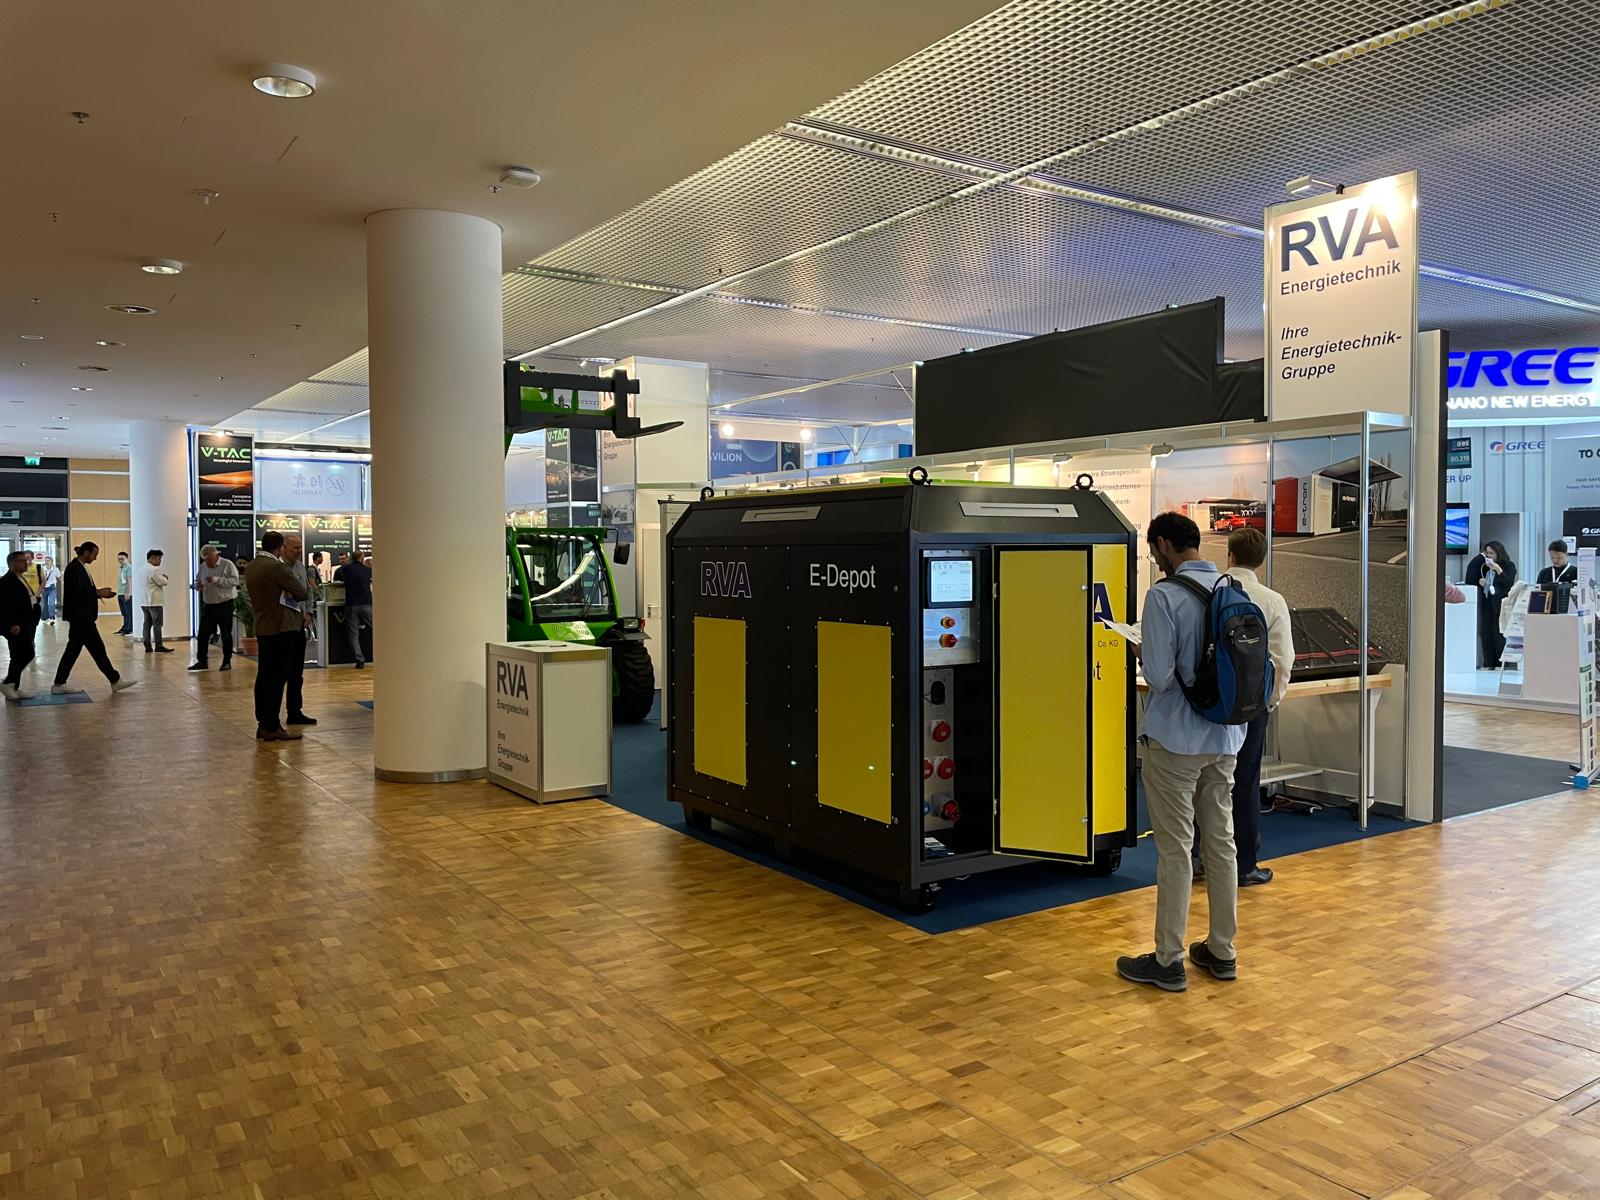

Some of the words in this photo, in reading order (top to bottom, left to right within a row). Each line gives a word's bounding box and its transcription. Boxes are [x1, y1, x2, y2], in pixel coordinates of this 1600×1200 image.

[1281, 206, 1399, 272] RVA
[1281, 260, 1401, 295] Energietechnik
[1281, 326, 1309, 340] Ihre
[1281, 330, 1402, 360] Energietechnik-
[1281, 363, 1336, 380] Gruppe
[1491, 395, 1528, 408] NEW
[547, 429, 568, 442] V-TAC
[200, 446, 251, 458] V-TAC
[1506, 440, 1546, 451] GREE
[1578, 449, 1593, 459] TO
[1459, 475, 1472, 483] UP
[203, 518, 250, 528] V-TAC
[256, 519, 300, 529] V-TAC
[308, 519, 350, 529] V-TAC
[701, 562, 752, 598] RVA
[809, 563, 876, 594] E-Depot
[1109, 639, 1119, 647] KG
[497, 660, 529, 700] RVA
[497, 699, 529, 716] Energietechnik
[497, 757, 513, 772] Gruppe
